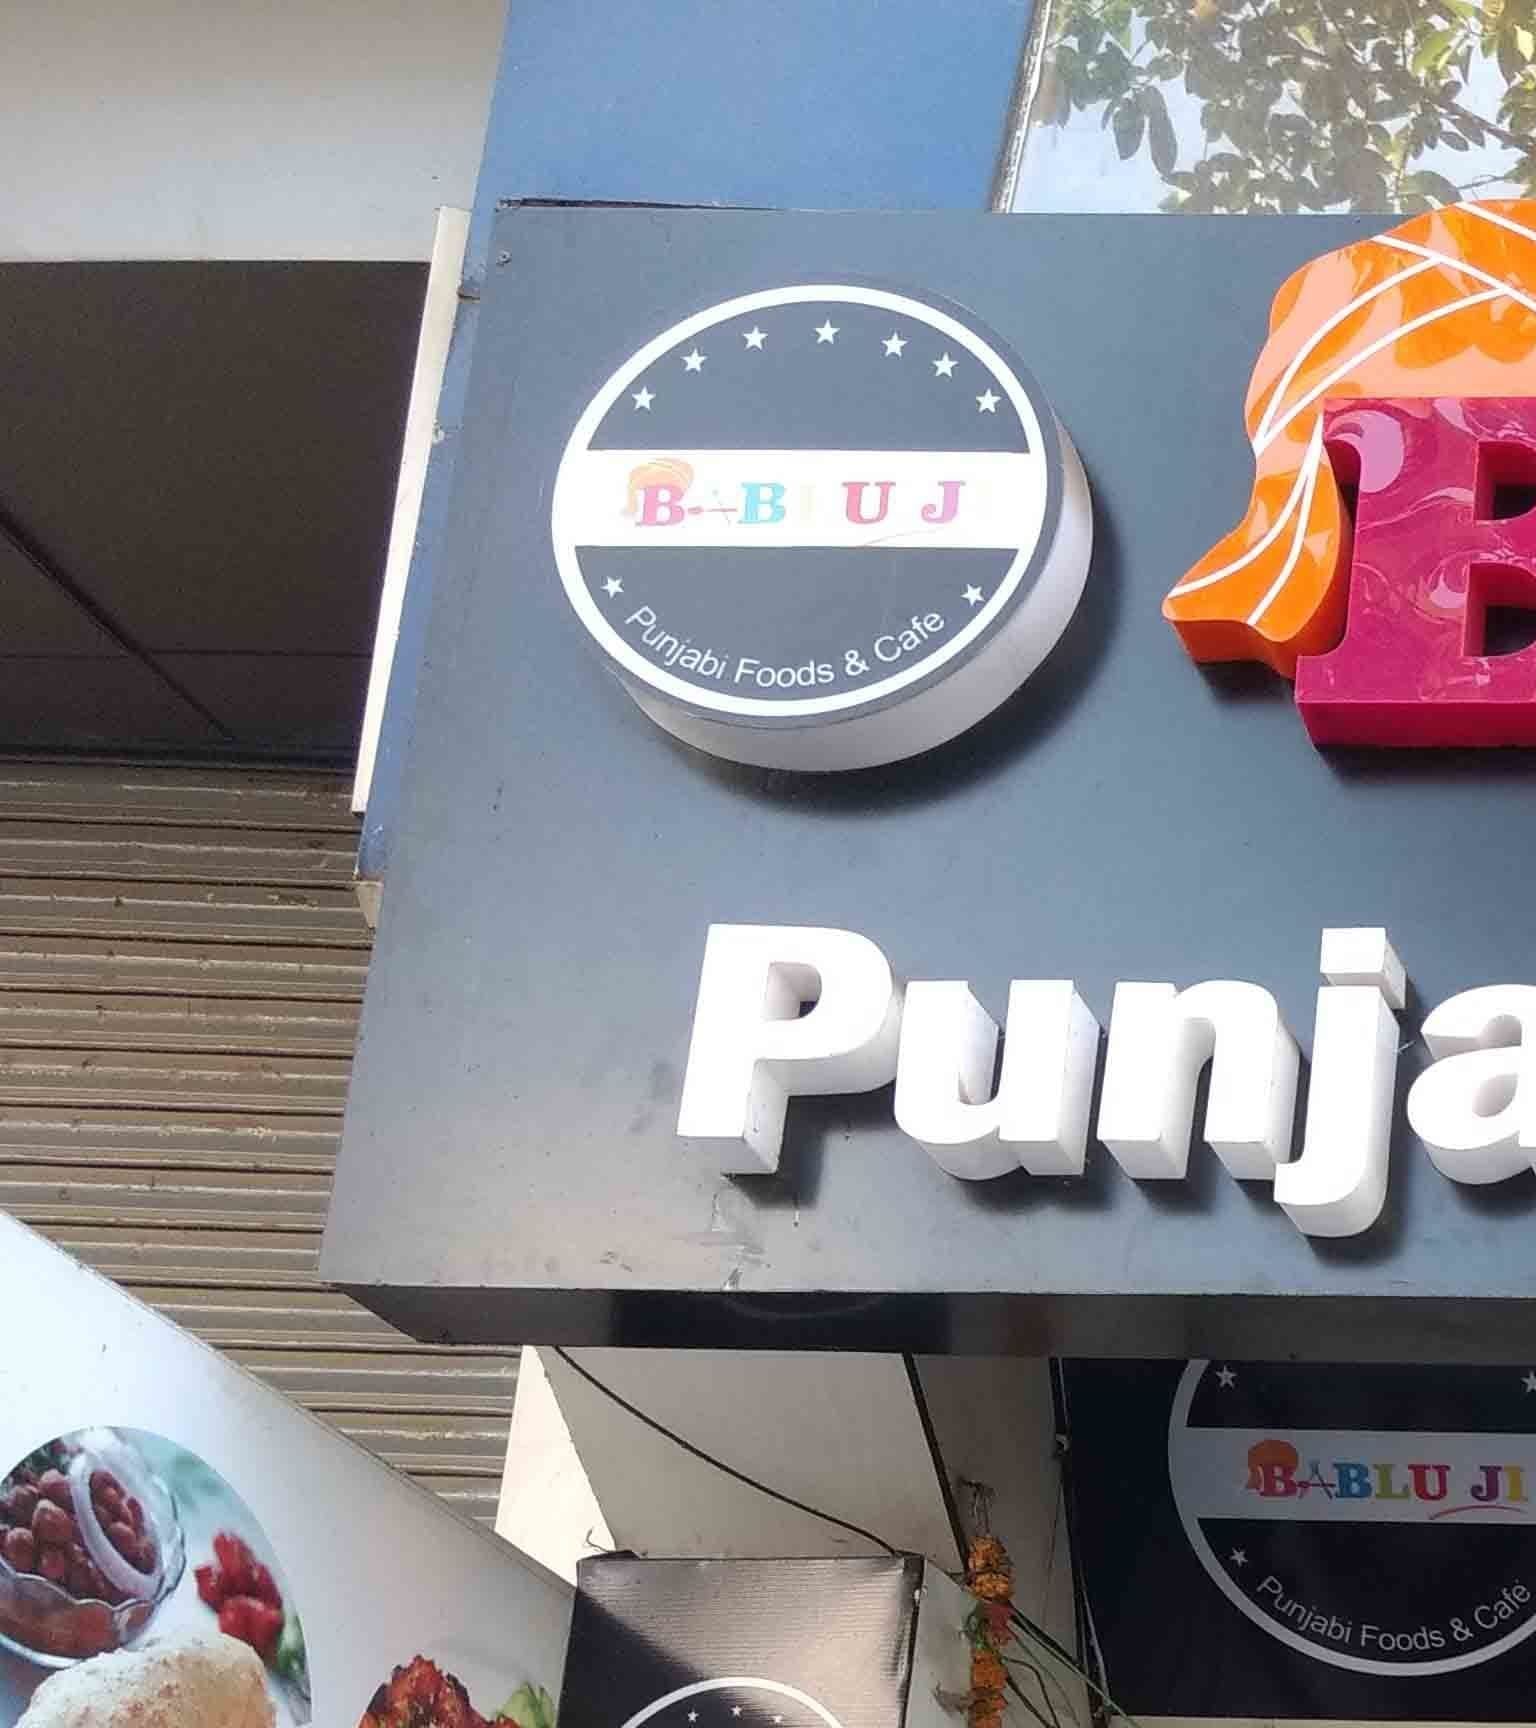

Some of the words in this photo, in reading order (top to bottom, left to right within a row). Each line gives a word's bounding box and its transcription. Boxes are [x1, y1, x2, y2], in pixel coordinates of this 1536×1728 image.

[623, 605, 727, 681] Punjabi
[732, 658, 835, 688] Foods
[844, 649, 870, 677] &
[1258, 1458, 1452, 1502] BABLU
[1470, 1464, 1530, 1503] JI
[1255, 1575, 1353, 1644] Punjabi
[1359, 1624, 1447, 1651] Foods
[1449, 1616, 1475, 1642] &
